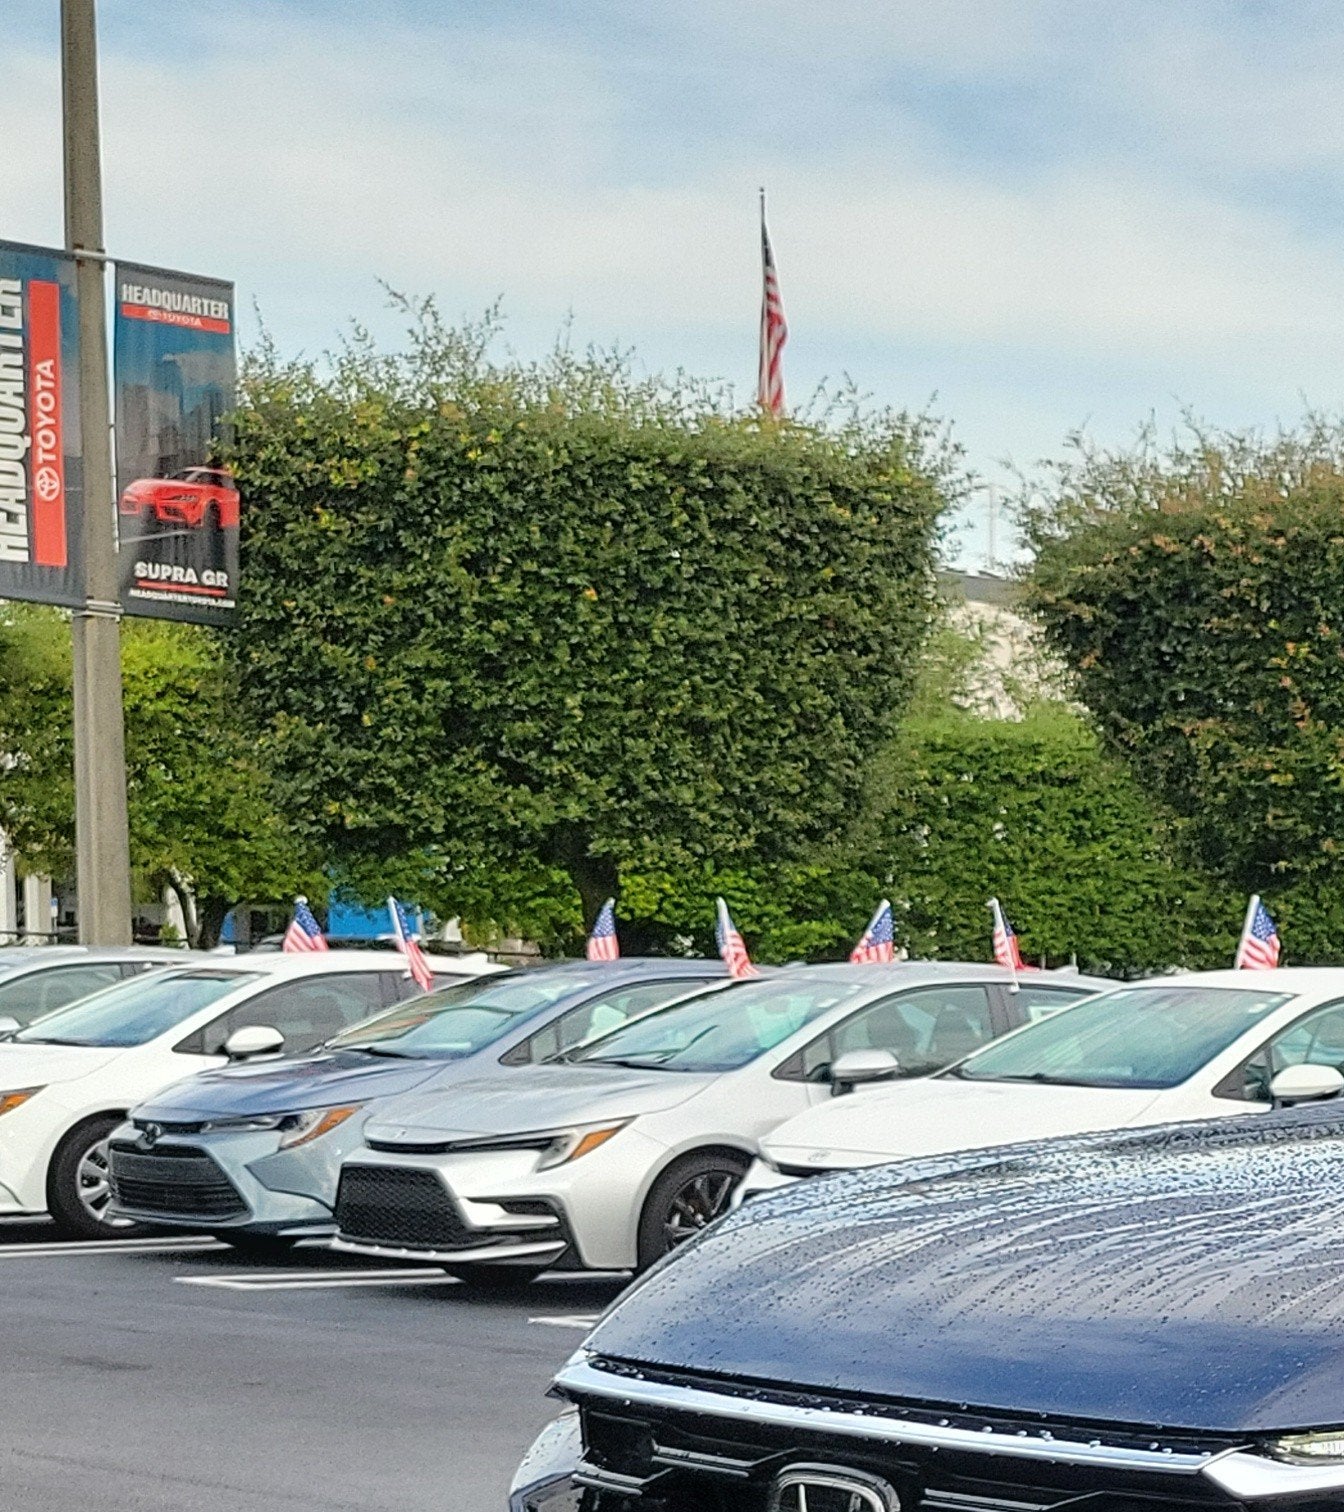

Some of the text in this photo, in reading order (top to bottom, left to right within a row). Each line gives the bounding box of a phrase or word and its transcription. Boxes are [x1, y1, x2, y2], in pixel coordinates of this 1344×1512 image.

[121, 283, 229, 320] HEADQUARTER
[163, 310, 203, 328] TOYOTA
[36, 358, 57, 464] TOYOTA
[134, 560, 229, 588] SUPRA GR
